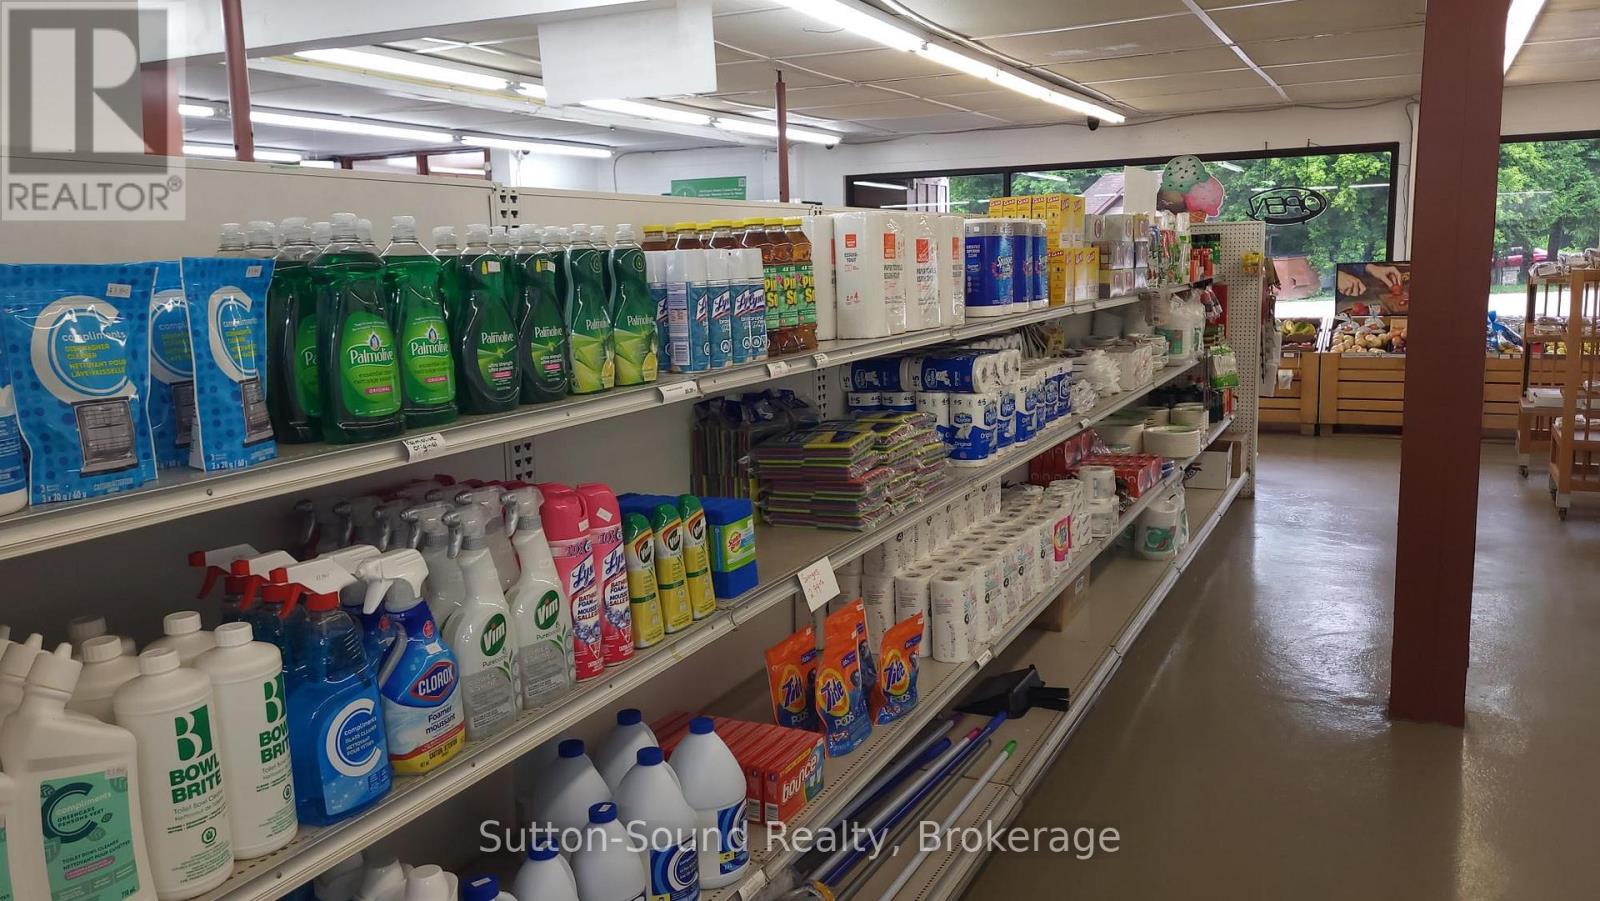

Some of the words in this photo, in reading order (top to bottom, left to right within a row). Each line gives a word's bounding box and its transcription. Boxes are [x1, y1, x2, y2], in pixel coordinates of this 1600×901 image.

[481, 331, 514, 344] Palmolive
[535, 325, 563, 338] Palmolive
[350, 348, 394, 364] Palmolive
[537, 598, 559, 625] Vim
[483, 621, 505, 651] Vim
[418, 664, 454, 696] CLOROX
[882, 660, 906, 690] Tide
[821, 677, 846, 712] Tide
[169, 753, 219, 787] BOWL
[782, 754, 817, 804] bounce
[171, 769, 222, 804] BRITE
